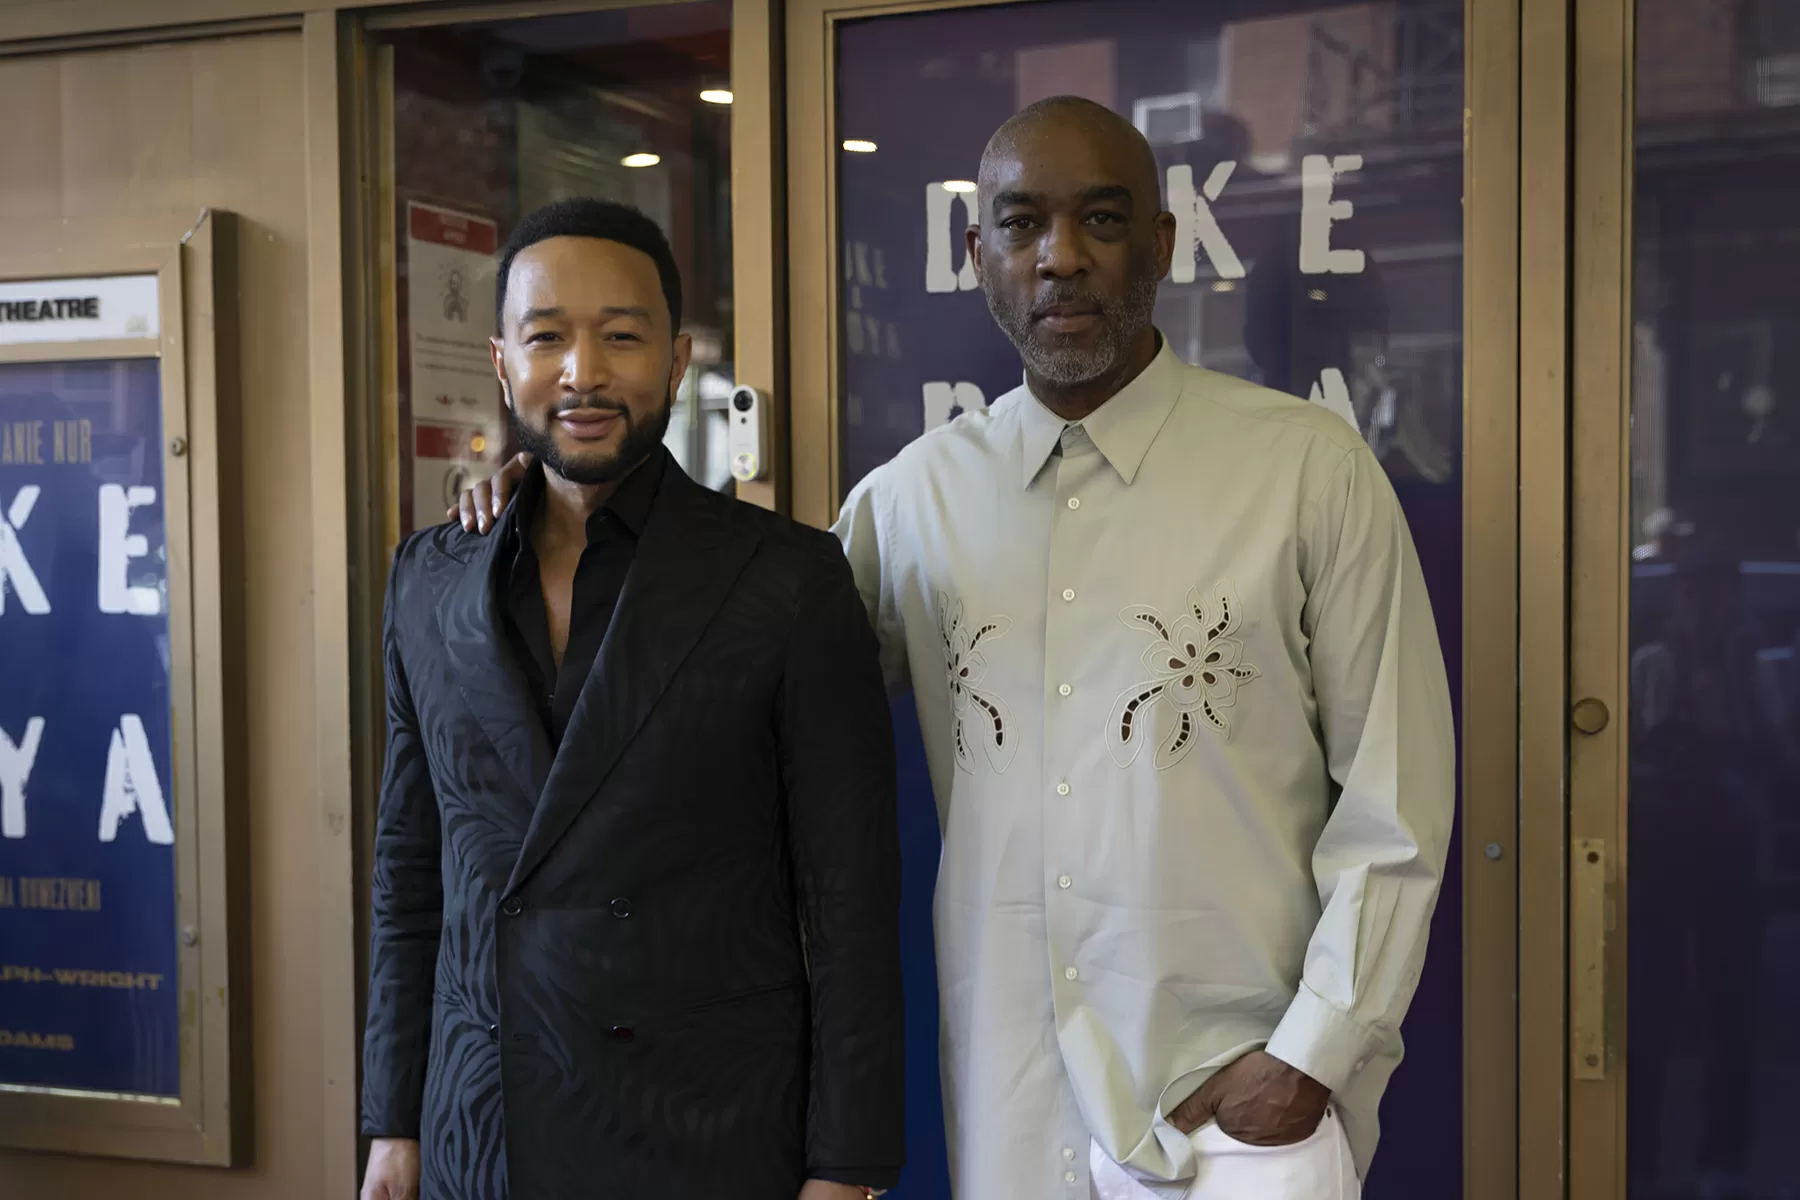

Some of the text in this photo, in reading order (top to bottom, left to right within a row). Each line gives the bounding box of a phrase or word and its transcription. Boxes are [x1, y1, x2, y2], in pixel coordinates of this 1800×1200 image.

[925, 154, 1365, 293] DKE
[3, 418, 92, 464] ANIE NUR
[0, 714, 175, 845] YA
[0, 966, 164, 990] PH-WRIGHT
